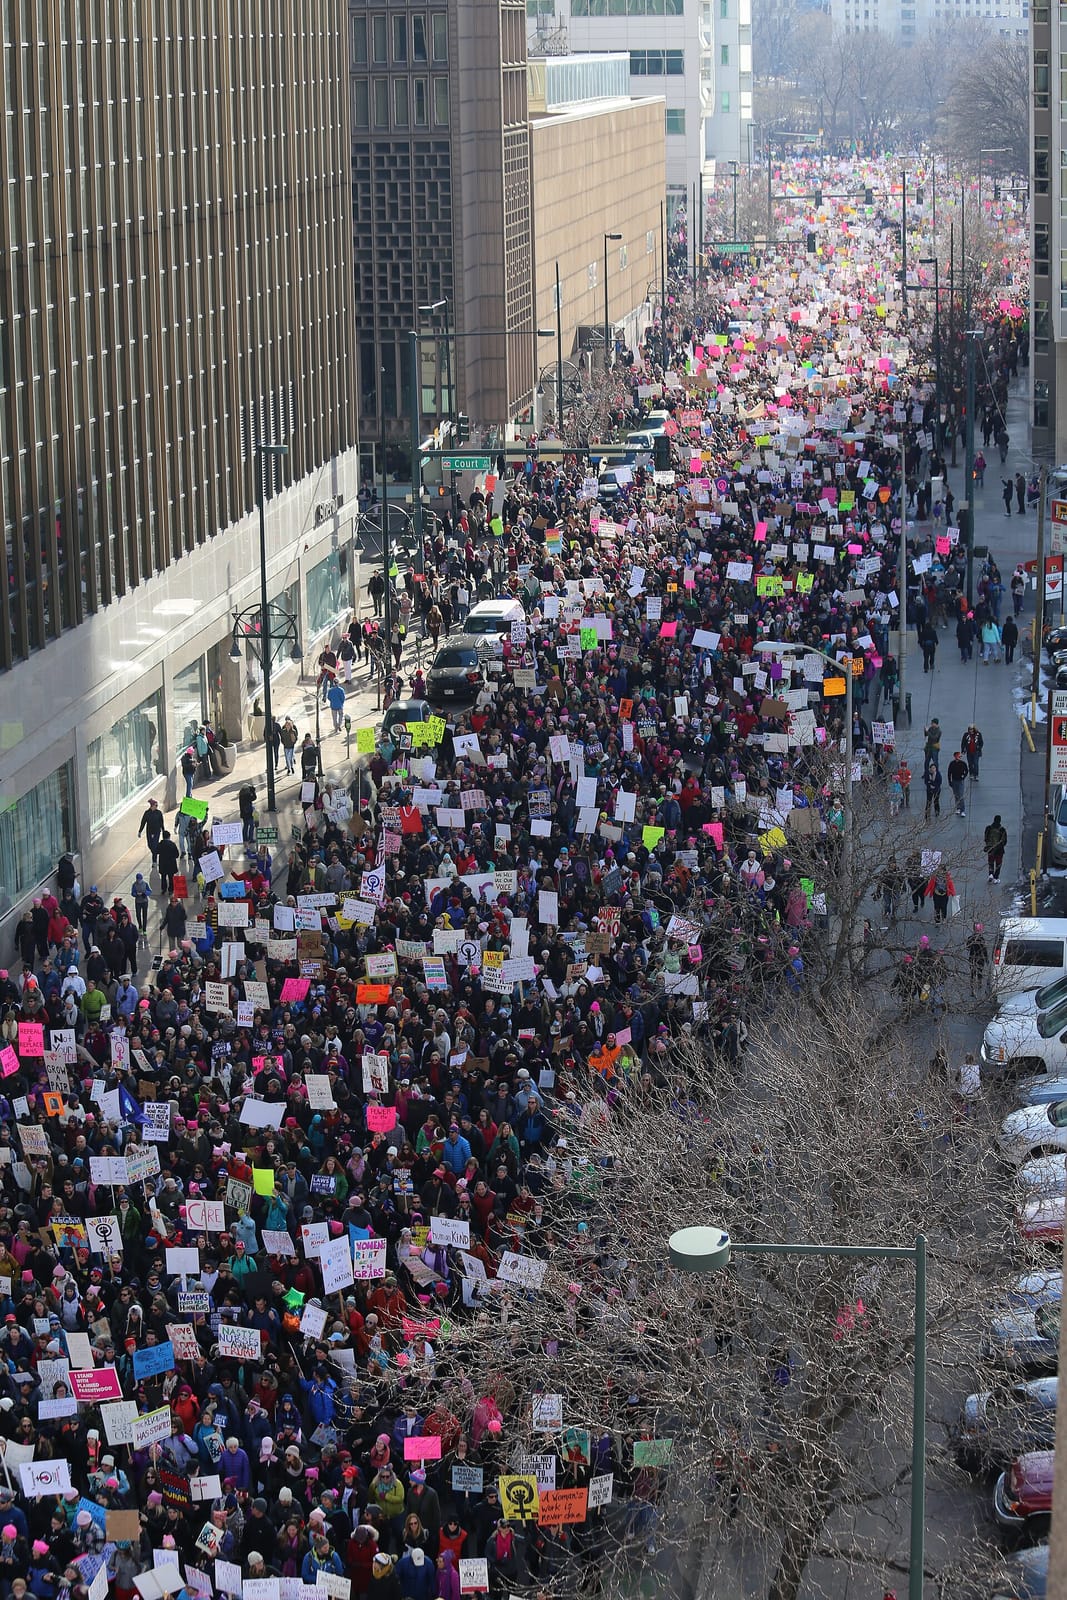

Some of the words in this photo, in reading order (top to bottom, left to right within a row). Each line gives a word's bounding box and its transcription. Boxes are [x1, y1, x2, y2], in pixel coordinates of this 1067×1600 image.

[454, 459, 478, 468] Court
[214, 826, 240, 835] RESIST
[496, 883, 512, 891] VOICE
[361, 891, 381, 899] PEOPLE
[483, 981, 506, 990] EQUALITY
[119, 1036, 129, 1044] THE
[46, 1064, 66, 1074] GROW
[56, 1074, 61, 1082] A
[50, 1081, 68, 1091] PAIR
[188, 1203, 222, 1227] CARE
[334, 1271, 352, 1283] NATION
[354, 1267, 384, 1278] GRABS
[222, 1326, 255, 1338] NASTY
[219, 1334, 259, 1348] NURSES
[222, 1345, 257, 1358] TRUMP
[144, 1411, 169, 1426] REVOLUTION
[136, 1429, 149, 1441] HAS
[148, 1420, 170, 1436] STARTED
[540, 1455, 552, 1463] NOT
[162, 1488, 188, 1503] HUMAN
[541, 1493, 549, 1502] A
[541, 1504, 560, 1513] work
